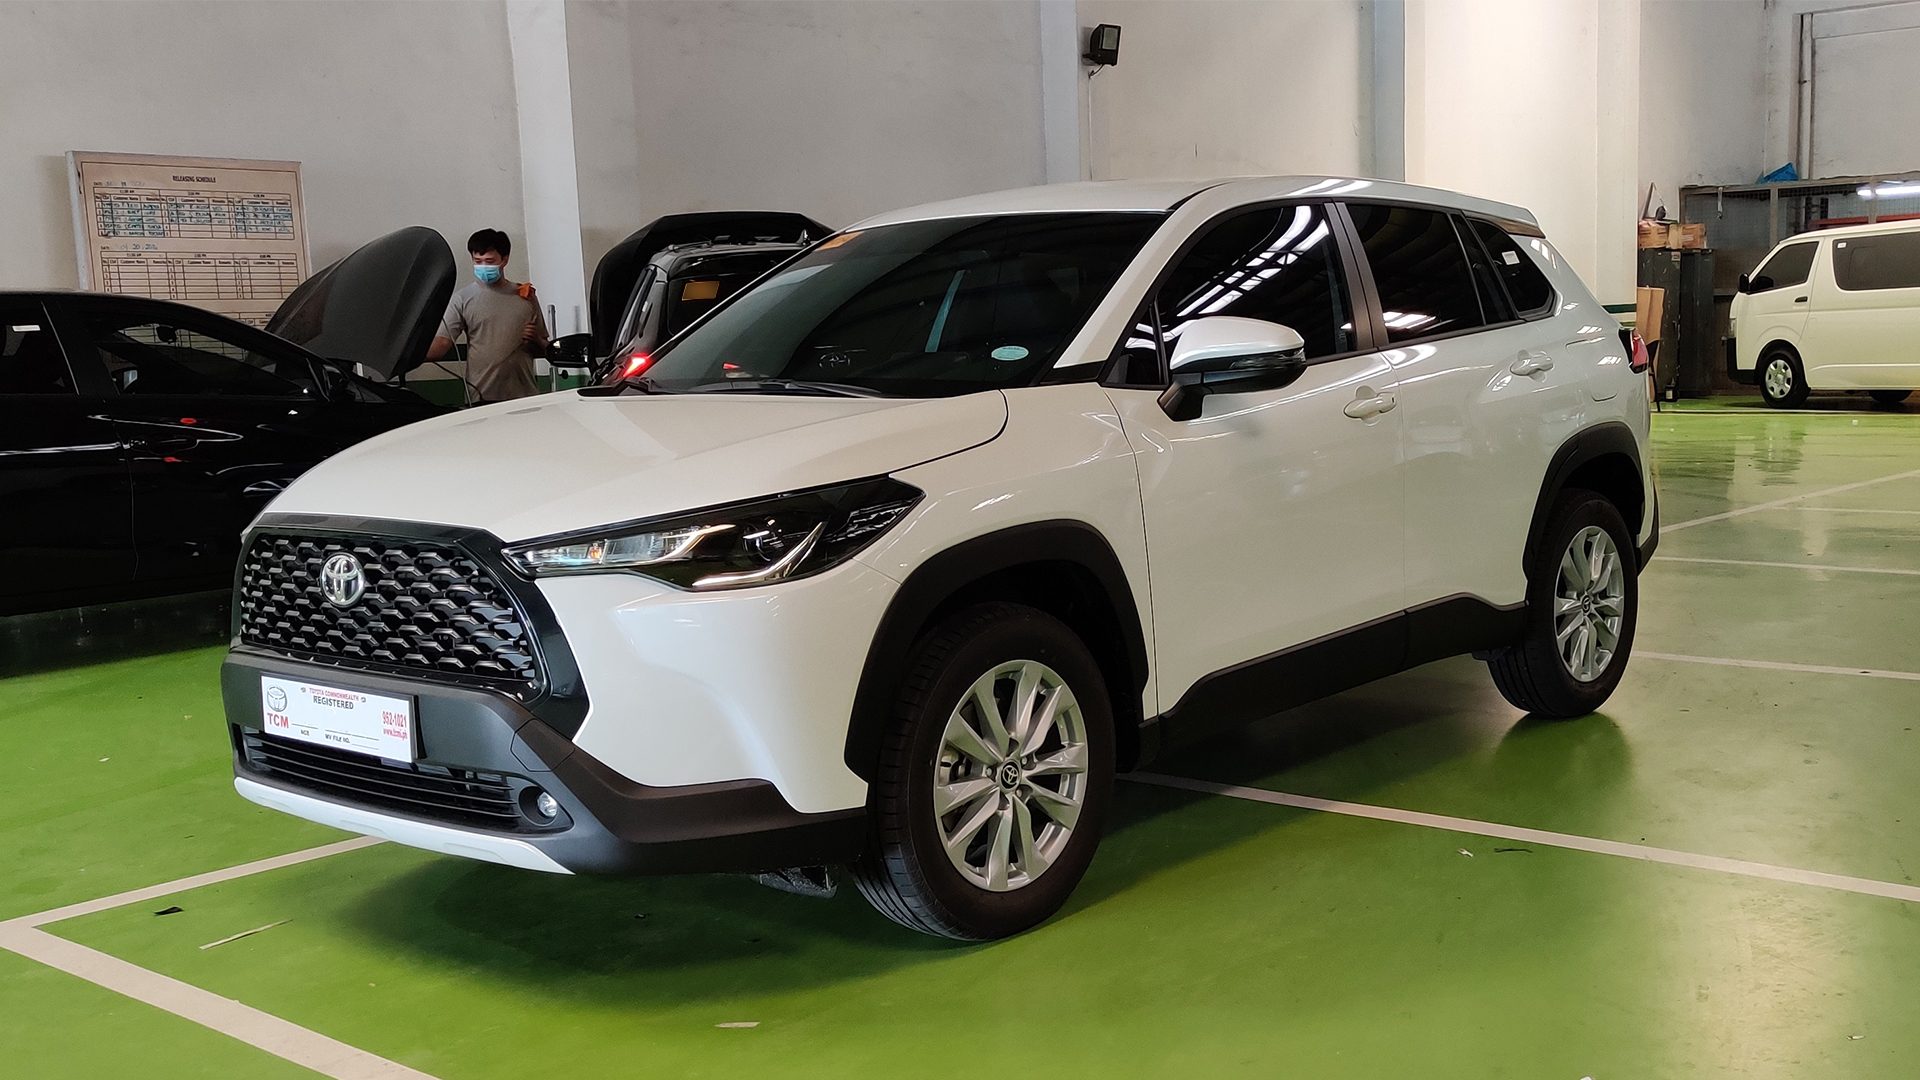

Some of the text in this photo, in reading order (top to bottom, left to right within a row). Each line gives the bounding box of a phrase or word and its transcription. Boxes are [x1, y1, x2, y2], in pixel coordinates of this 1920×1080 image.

[172, 175, 216, 184] RELEASING SCHEDULE
[309, 687, 325, 697] TOYOTA
[313, 695, 354, 710] REGISTERED
[267, 712, 289, 729] TCM
